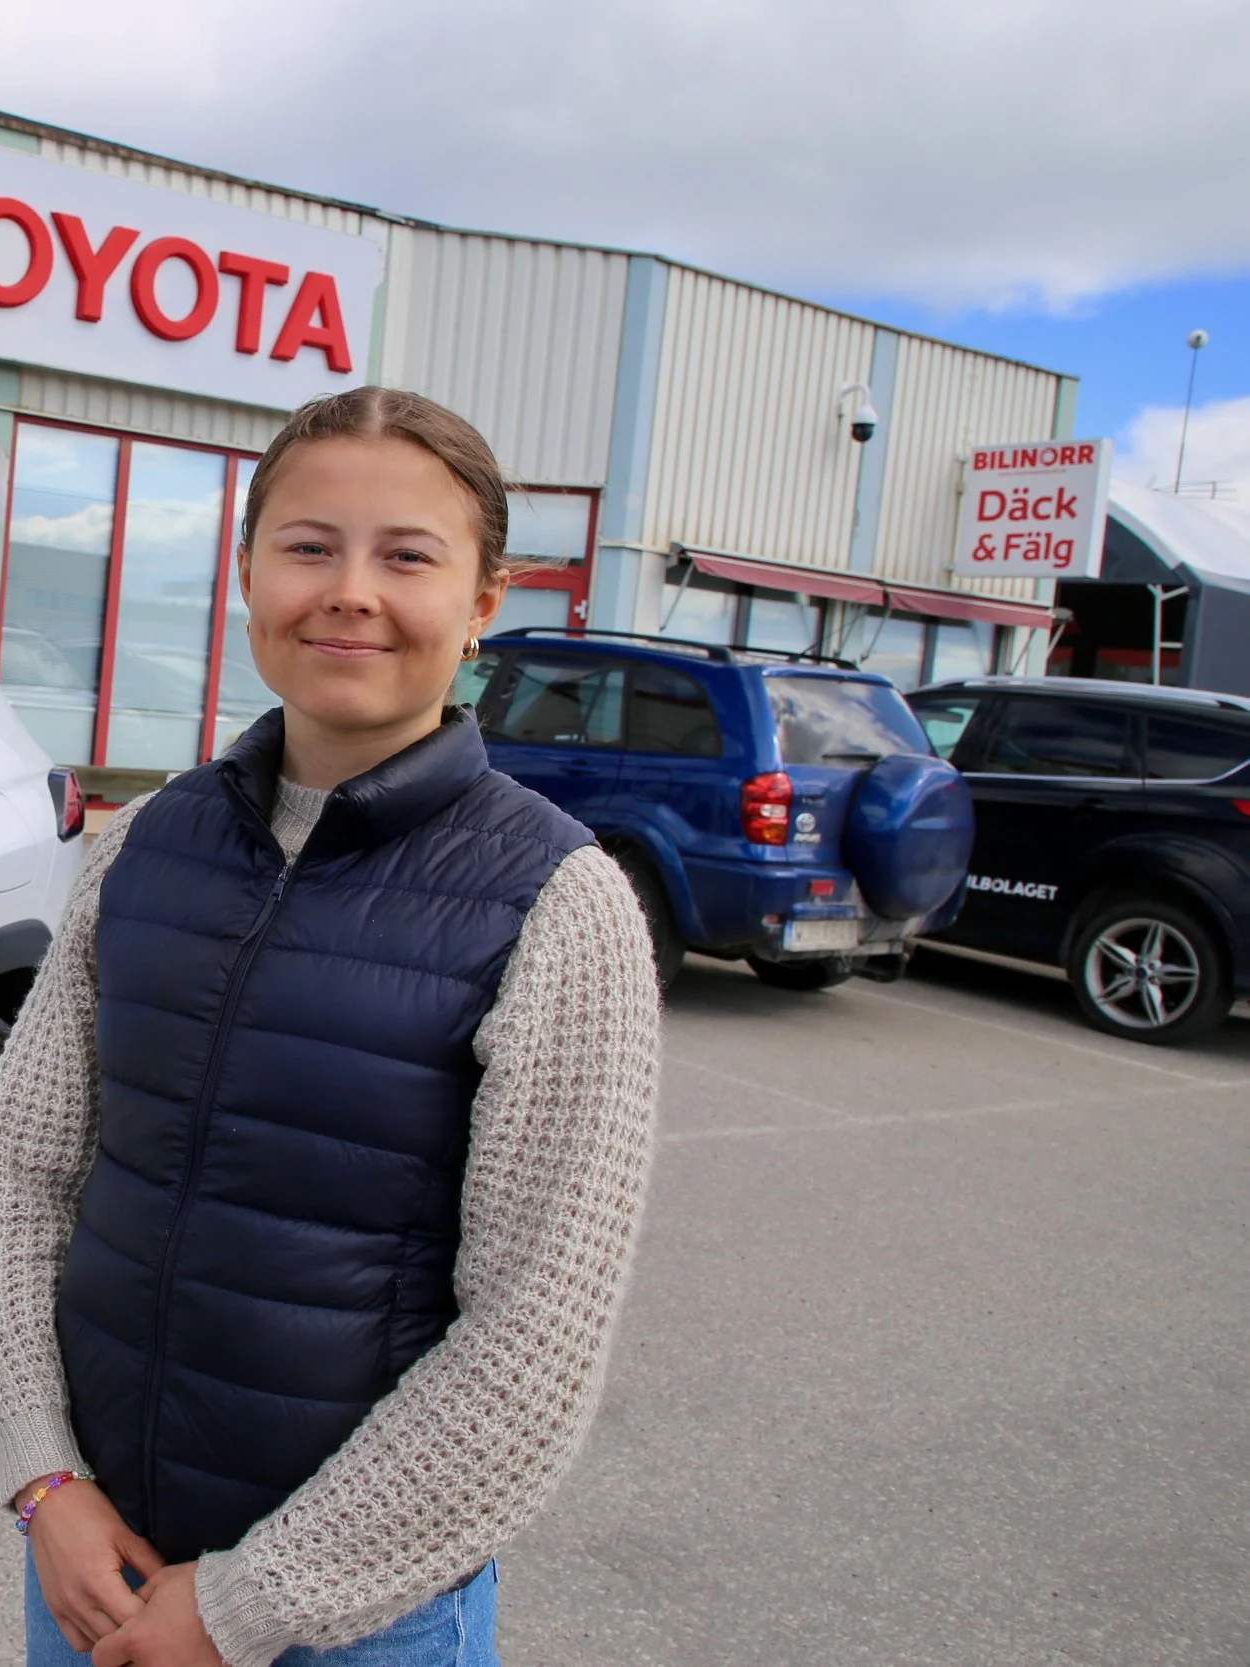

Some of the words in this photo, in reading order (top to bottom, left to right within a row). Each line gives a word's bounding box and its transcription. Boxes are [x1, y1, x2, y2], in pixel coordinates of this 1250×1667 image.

[973, 444, 1095, 471] BILINORR
[976, 486, 1078, 522] Däck
[971, 532, 996, 562] &
[1003, 531, 1075, 569] Fälg
[966, 873, 1059, 901] ILBOLAGET
